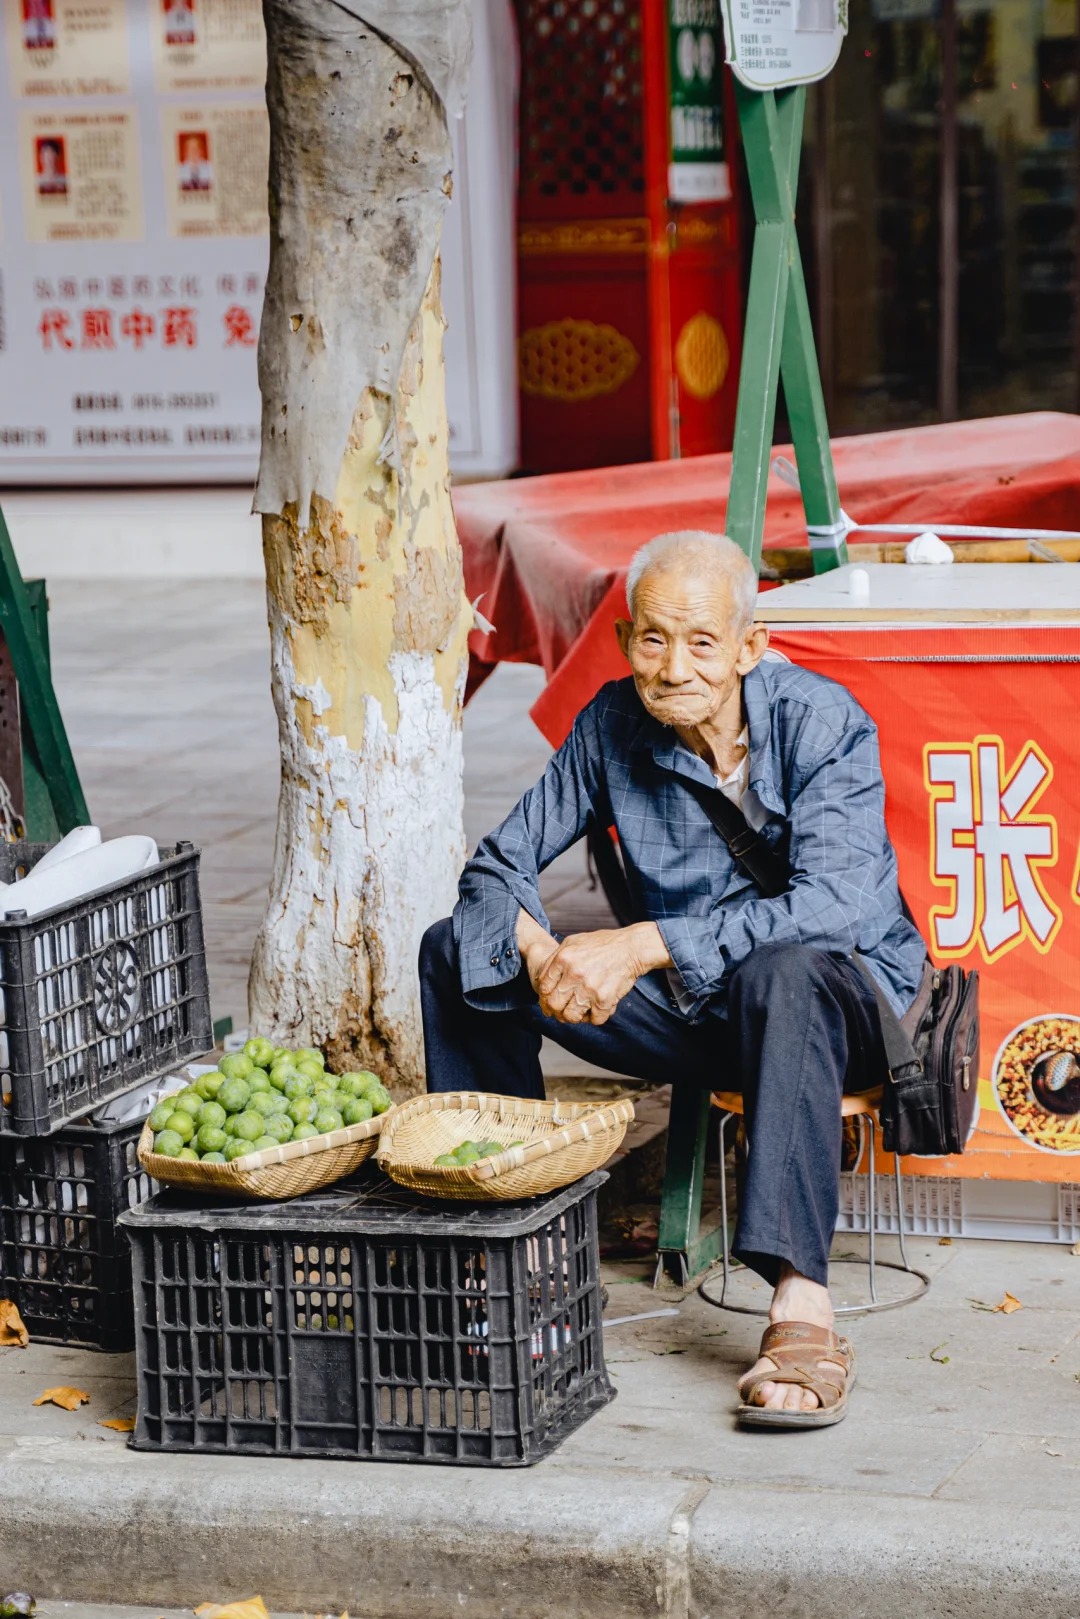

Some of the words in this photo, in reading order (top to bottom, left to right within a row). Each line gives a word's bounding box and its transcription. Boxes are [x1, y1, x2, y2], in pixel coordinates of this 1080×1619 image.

[39, 306, 197, 350] 代煎中药
[922, 733, 1080, 965] 张
